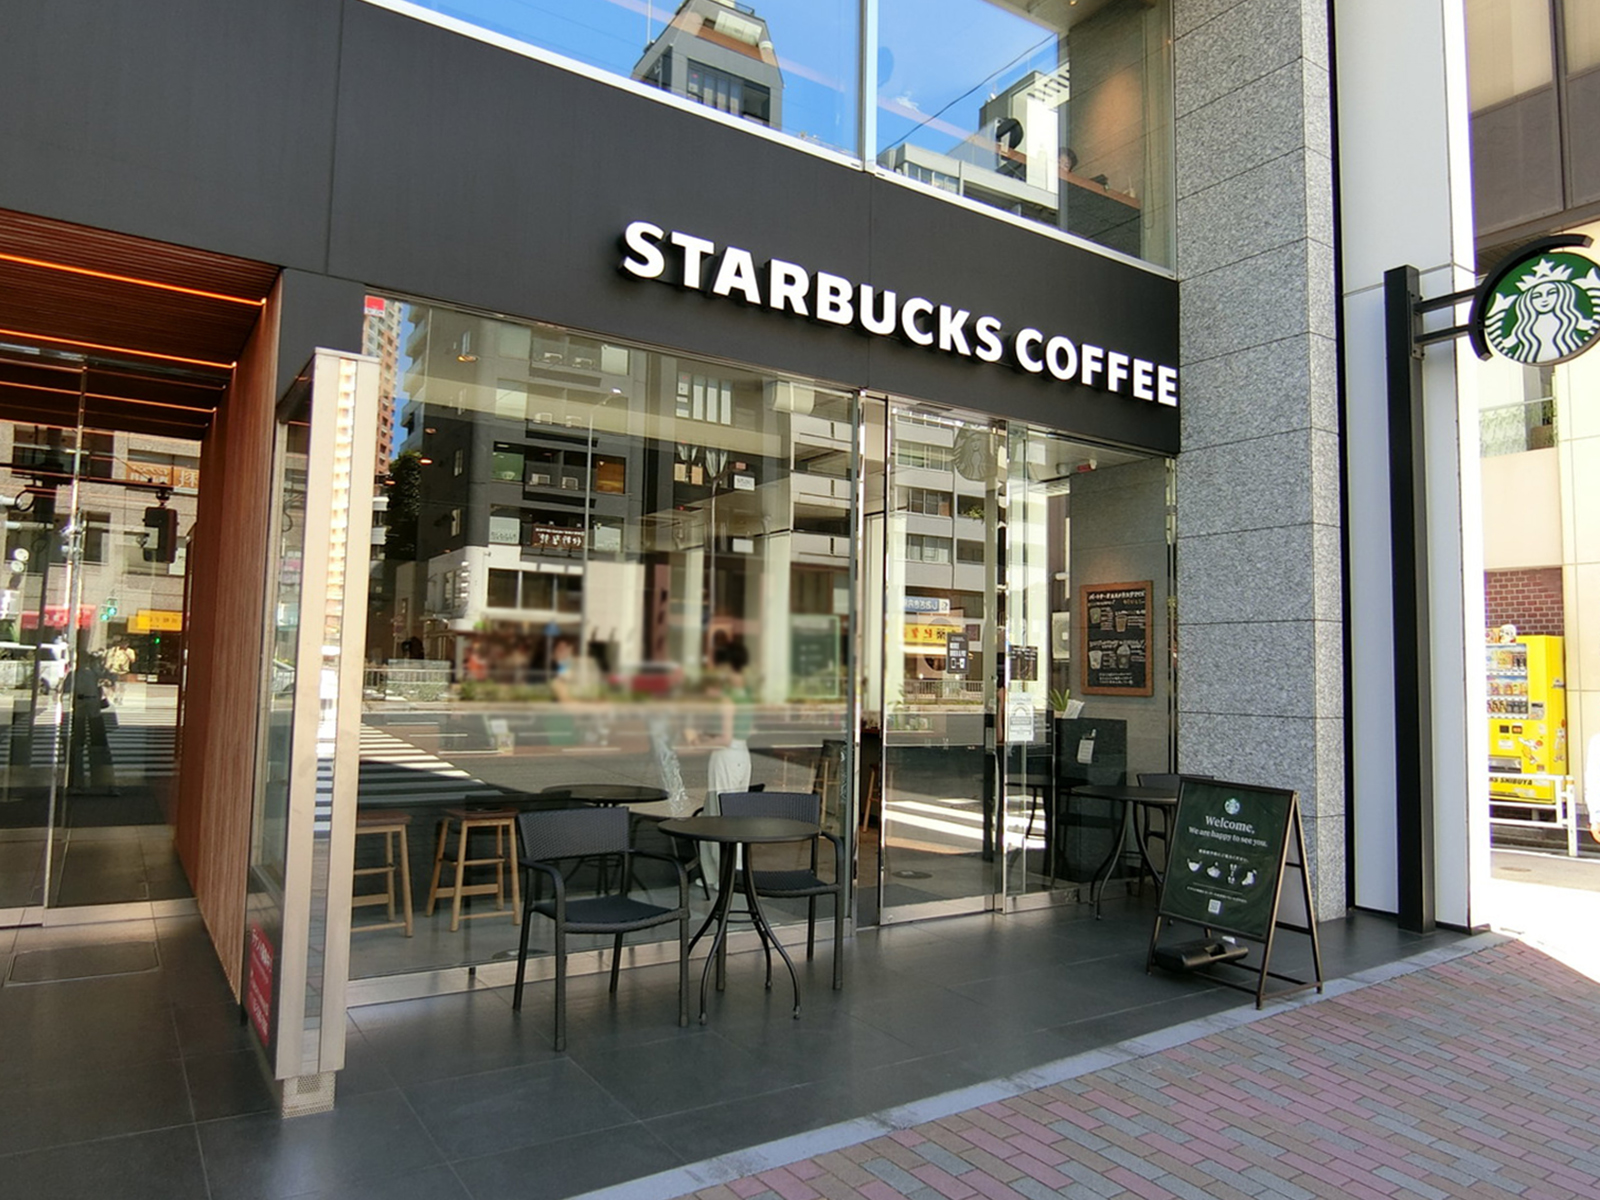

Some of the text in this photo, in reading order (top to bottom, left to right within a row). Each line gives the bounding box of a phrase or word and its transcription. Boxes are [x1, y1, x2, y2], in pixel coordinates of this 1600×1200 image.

[624, 222, 1178, 408] STARBUCKS COFFEE
[1188, 825, 1199, 835] We
[1211, 829, 1232, 842] happy
[1232, 834, 1240, 842] to
[1240, 837, 1252, 845] see
